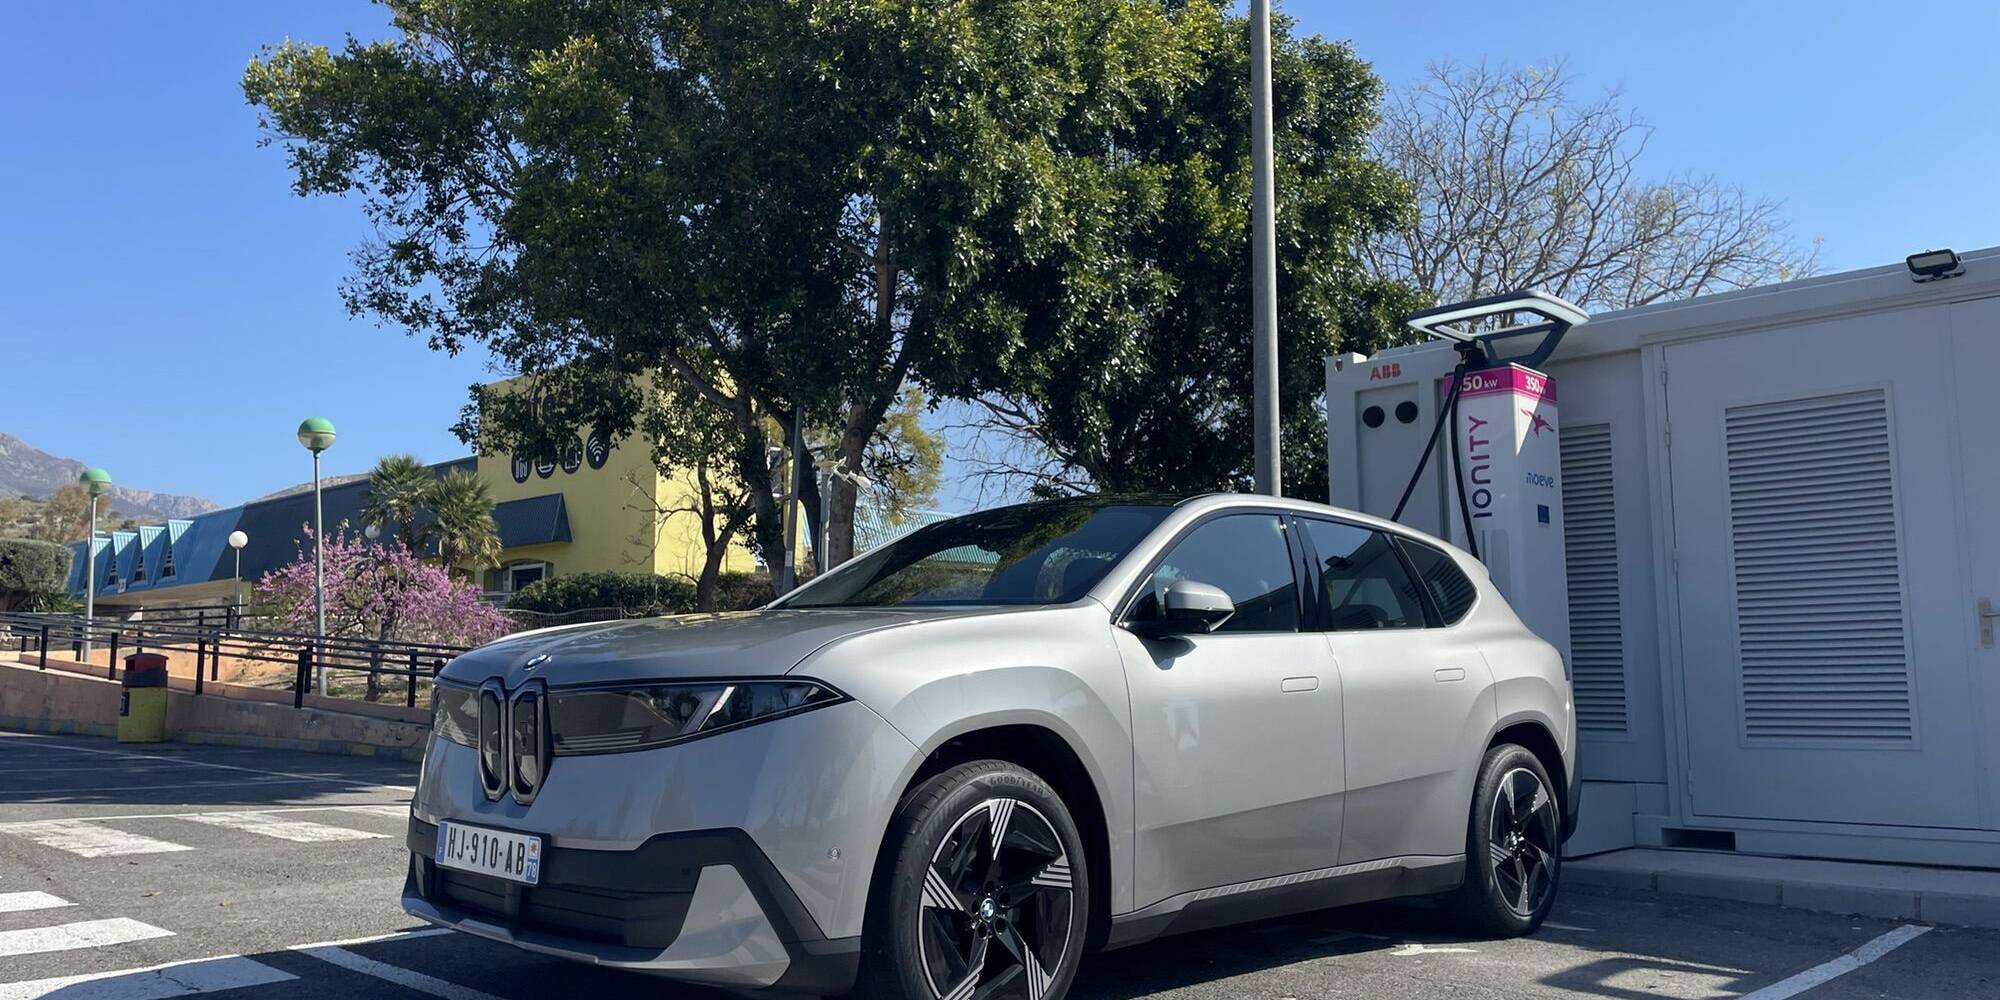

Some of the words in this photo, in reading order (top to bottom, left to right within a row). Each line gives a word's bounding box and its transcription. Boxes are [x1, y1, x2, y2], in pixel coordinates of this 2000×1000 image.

[1370, 363, 1402, 380] ABB
[1459, 375, 1483, 392] 50
[1525, 375, 1540, 392] 350
[527, 861, 537, 878] 78
